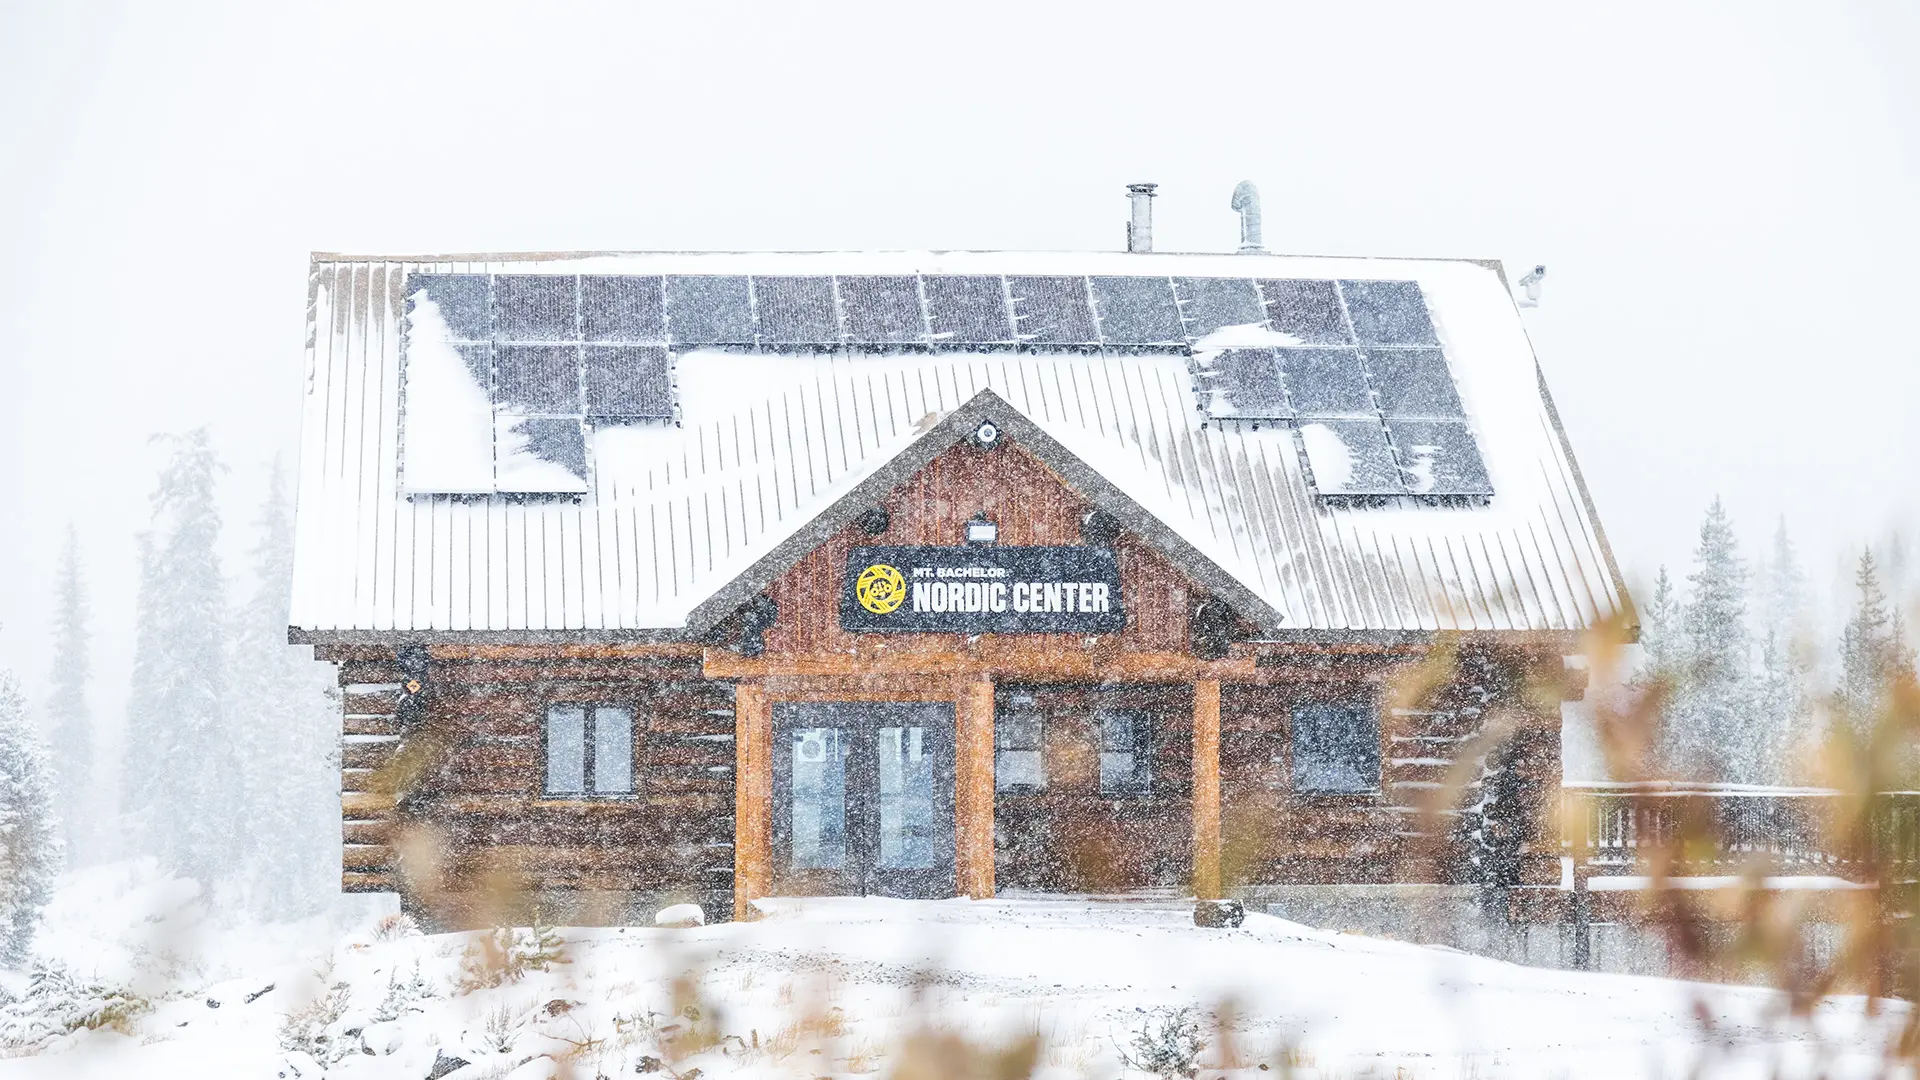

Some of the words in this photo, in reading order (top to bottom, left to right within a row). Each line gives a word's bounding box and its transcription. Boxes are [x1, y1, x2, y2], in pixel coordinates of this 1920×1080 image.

[913, 568, 934, 578] MT.
[937, 568, 1006, 578] BACHELOR
[913, 582, 1007, 612] NORDIC
[1013, 582, 1109, 612] CENTER
